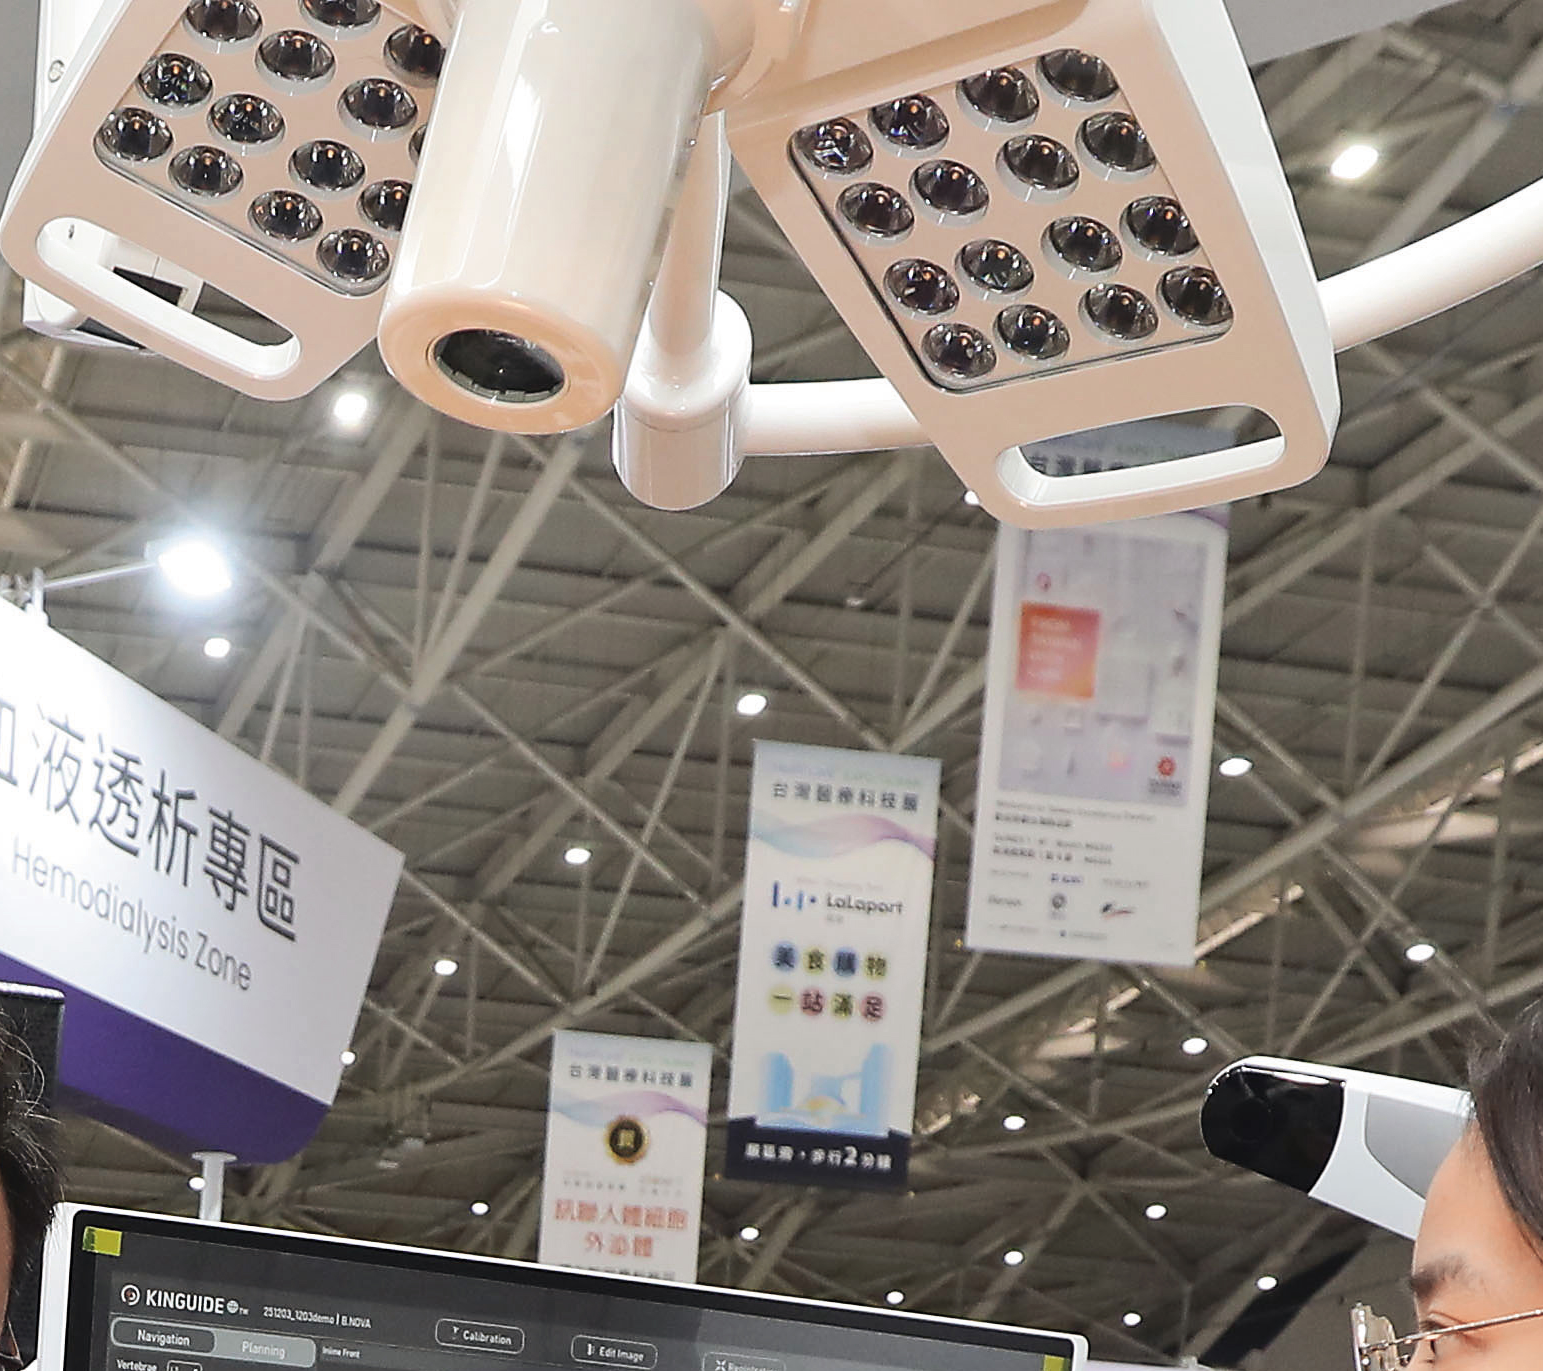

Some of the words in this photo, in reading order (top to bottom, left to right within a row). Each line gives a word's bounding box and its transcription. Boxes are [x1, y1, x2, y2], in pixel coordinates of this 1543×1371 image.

[12, 835, 189, 959] Hemodialysis
[196, 933, 252, 994] Zone
[146, 1289, 224, 1314] KINGUIDE
[137, 1330, 190, 1347] Navigation
[464, 1329, 511, 1346] Calibration
[242, 1341, 285, 1359] Planning
[343, 1348, 361, 1359] Front
[599, 1346, 616, 1359] Edit
[617, 1349, 644, 1363] Image
